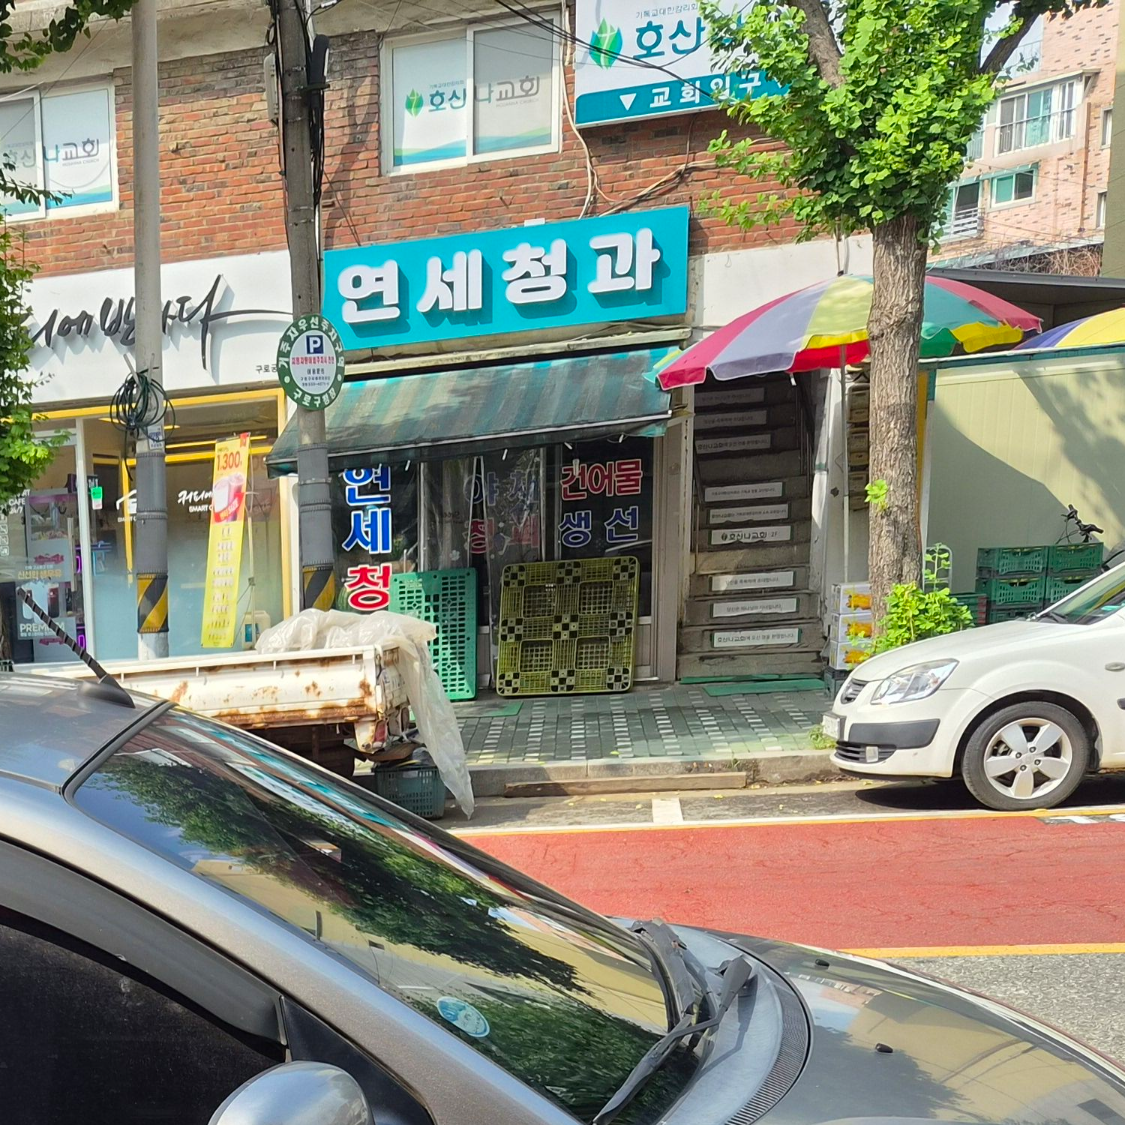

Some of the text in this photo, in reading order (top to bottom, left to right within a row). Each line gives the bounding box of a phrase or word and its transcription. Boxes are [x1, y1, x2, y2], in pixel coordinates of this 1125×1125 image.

[338, 228, 661, 324] 연세청과
[560, 459, 643, 501] 건어물
[558, 505, 639, 548] 생선
